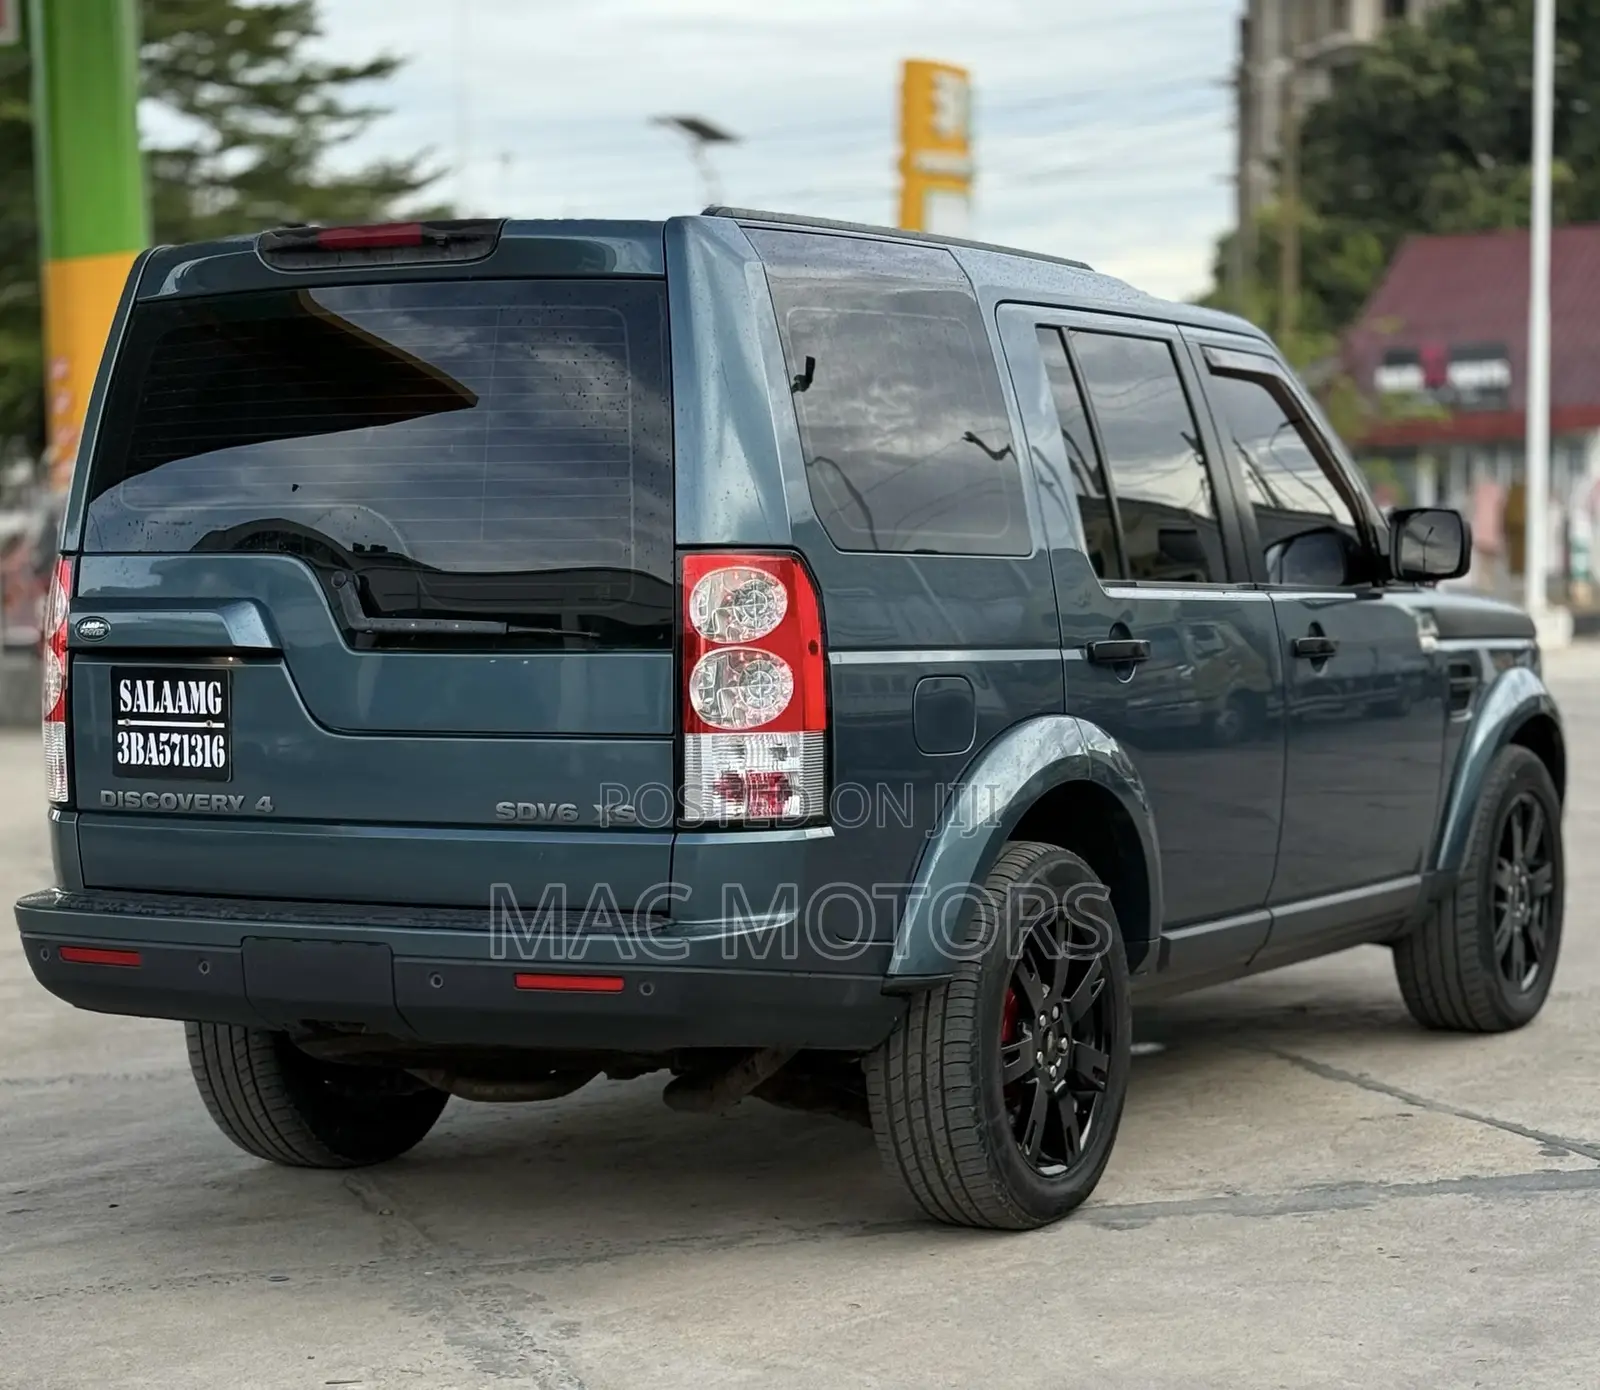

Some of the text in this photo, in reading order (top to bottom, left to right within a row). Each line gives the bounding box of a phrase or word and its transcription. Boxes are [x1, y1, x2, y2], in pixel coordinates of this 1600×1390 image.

[119, 679, 222, 714] SALAAMG
[117, 731, 226, 768] 3BA571316
[99, 789, 274, 813] DISCOVERY 4
[495, 801, 637, 823] SDV6 XS
